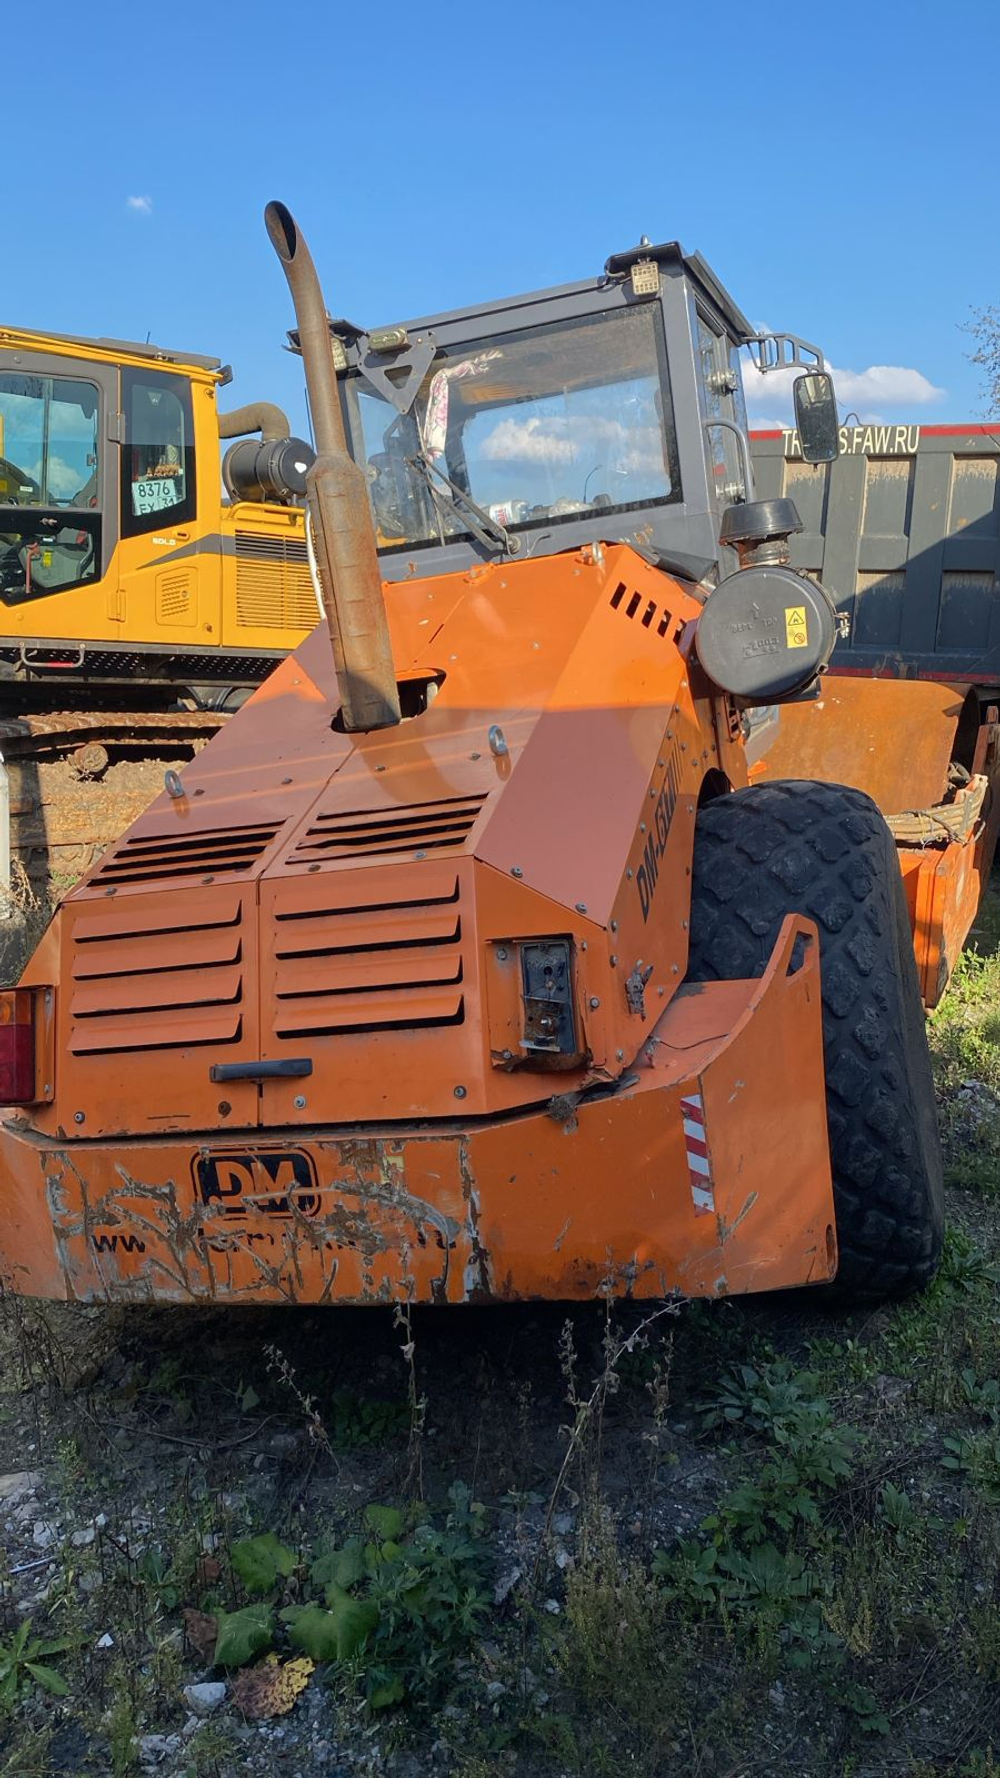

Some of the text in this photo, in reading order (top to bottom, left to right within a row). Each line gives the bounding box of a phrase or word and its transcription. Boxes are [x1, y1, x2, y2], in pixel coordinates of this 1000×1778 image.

[782, 426, 919, 456] TRS.FAW.RU
[138, 481, 170, 498] 8376
[214, 1160, 302, 1207] DM
